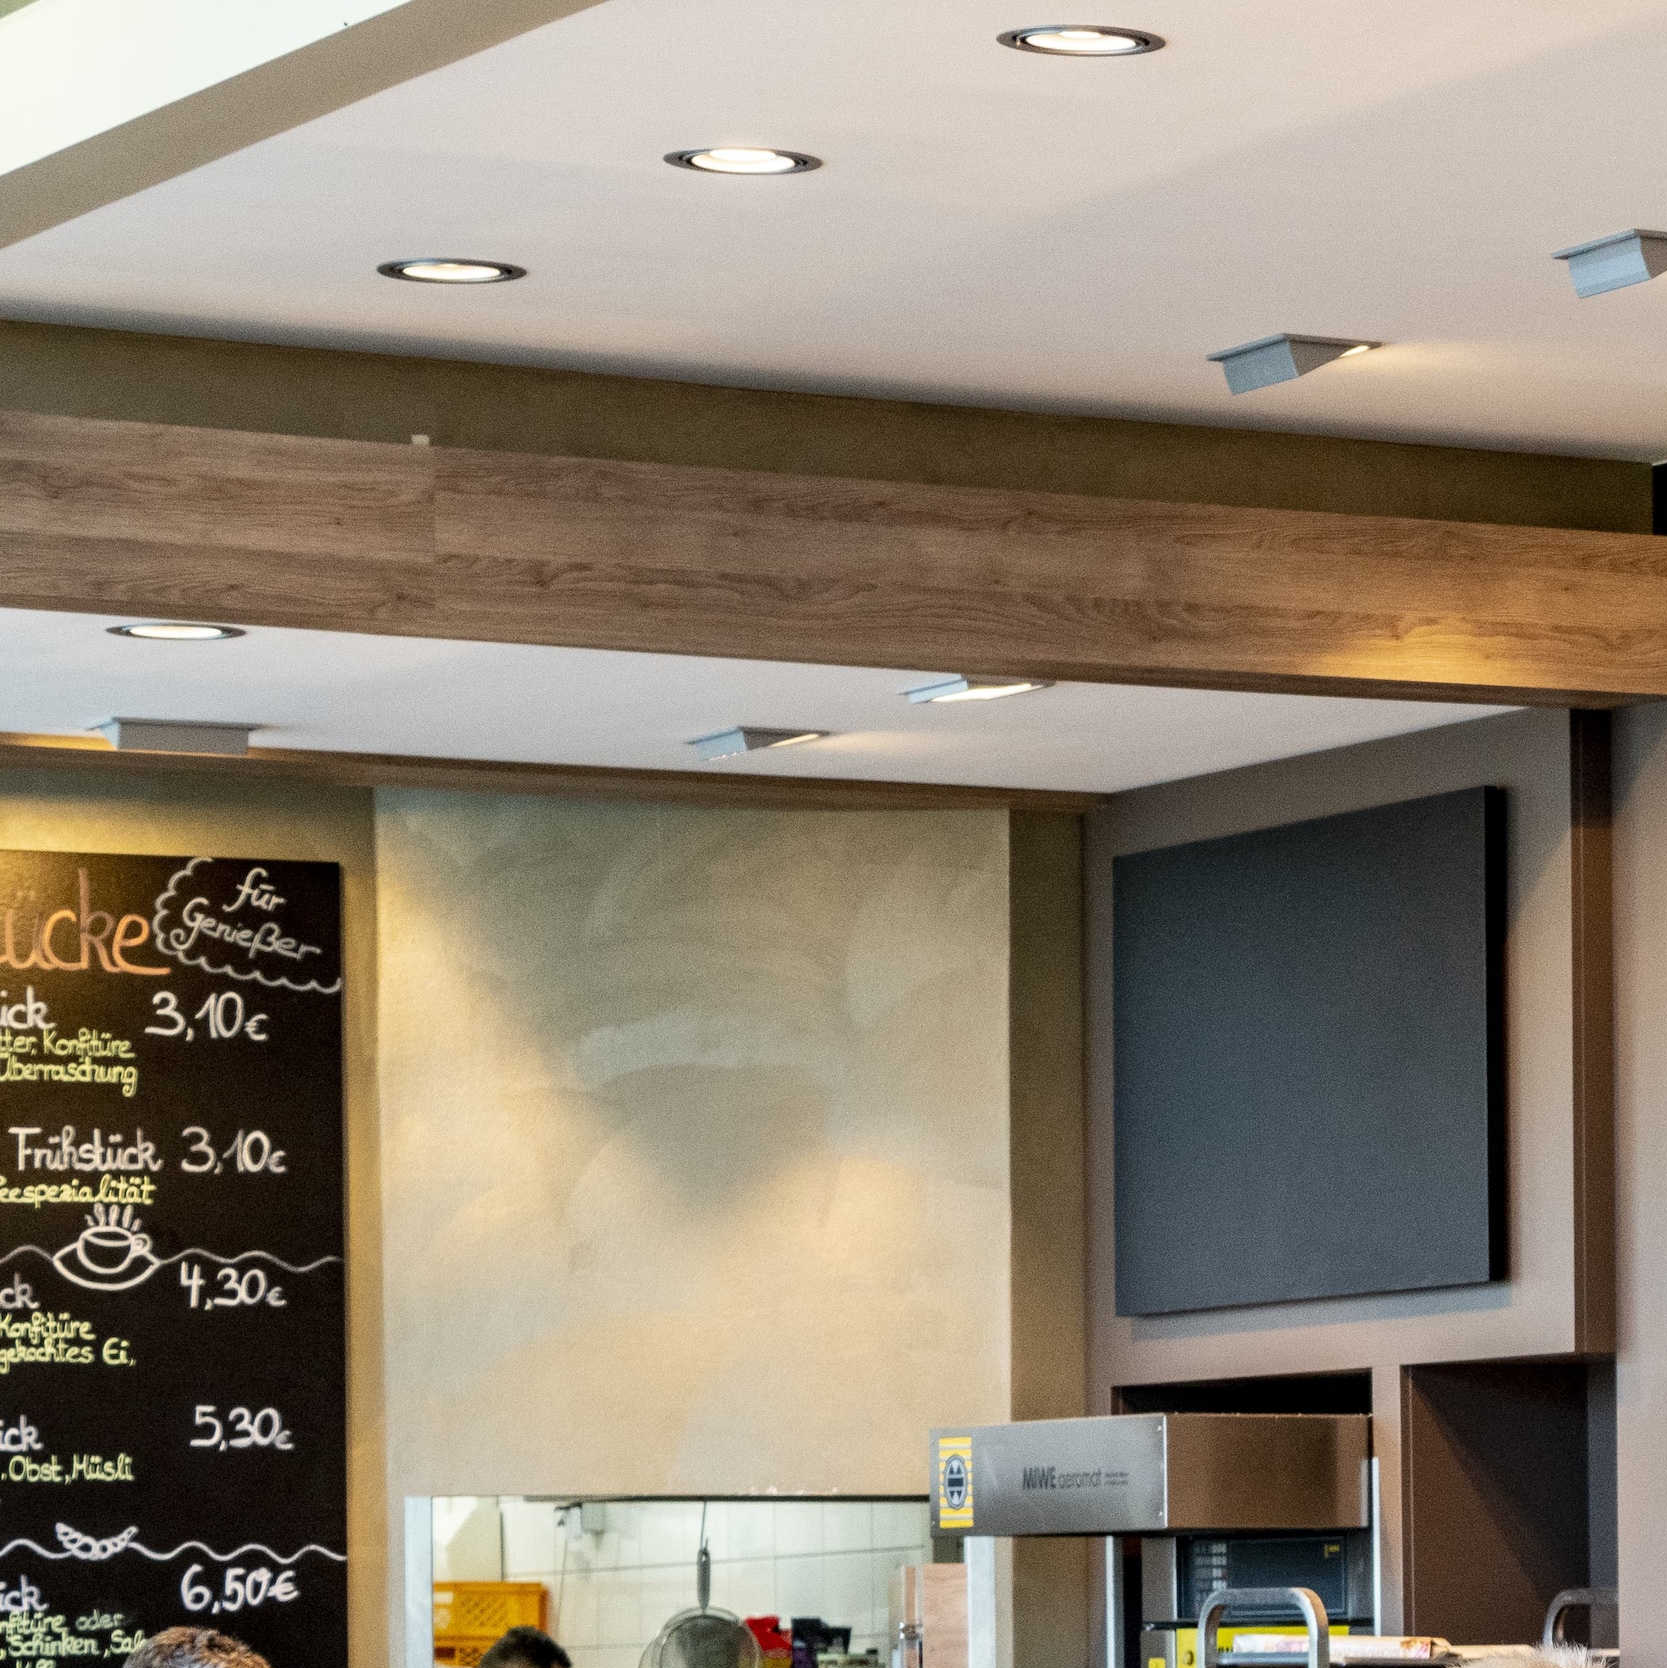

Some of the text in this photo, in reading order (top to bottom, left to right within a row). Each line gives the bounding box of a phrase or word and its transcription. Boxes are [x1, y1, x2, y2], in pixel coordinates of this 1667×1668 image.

[224, 867, 286, 913] für
[170, 898, 322, 960] Genießer
[8, 1125, 164, 1172] Frühstück
[1023, 1465, 1056, 1489] MIWE
